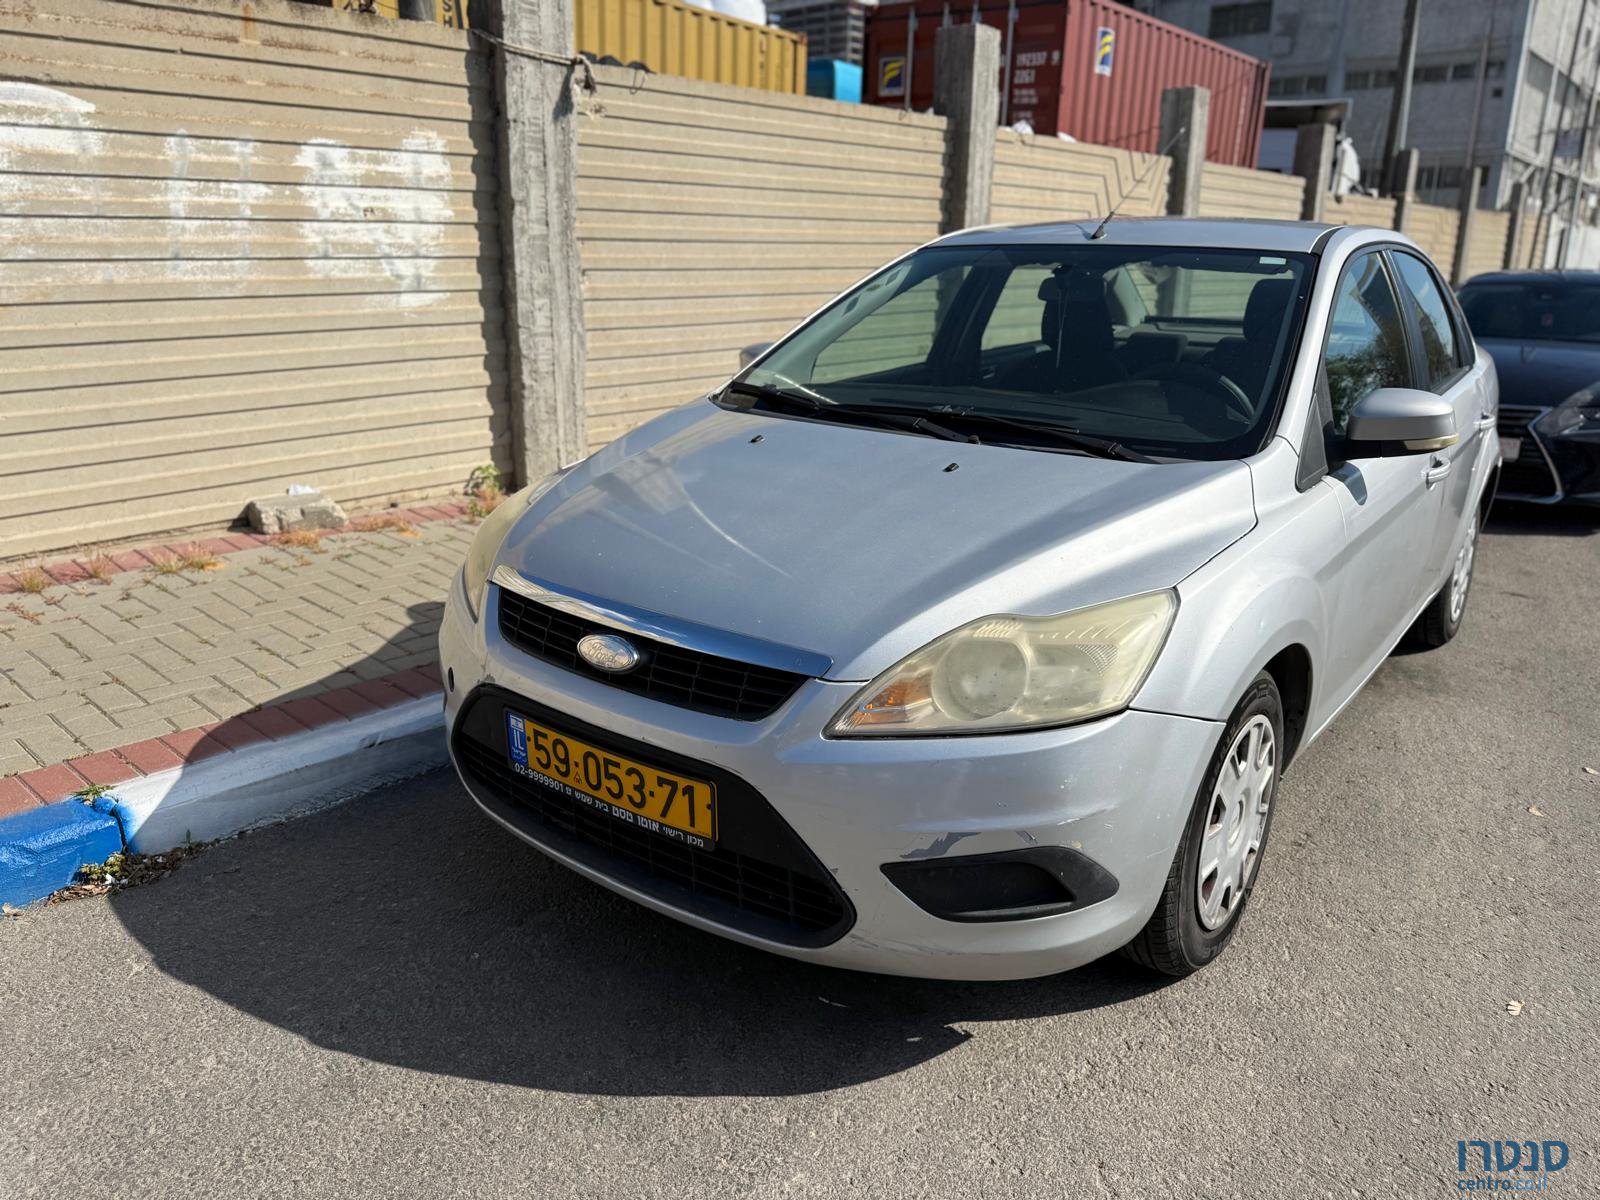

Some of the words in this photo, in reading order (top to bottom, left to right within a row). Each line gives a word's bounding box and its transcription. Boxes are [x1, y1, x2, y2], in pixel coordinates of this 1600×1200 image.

[574, 789, 593, 805] שמש
[594, 799, 609, 813] בית
[636, 815, 660, 833] אוטו
[687, 834, 704, 848] מכון
